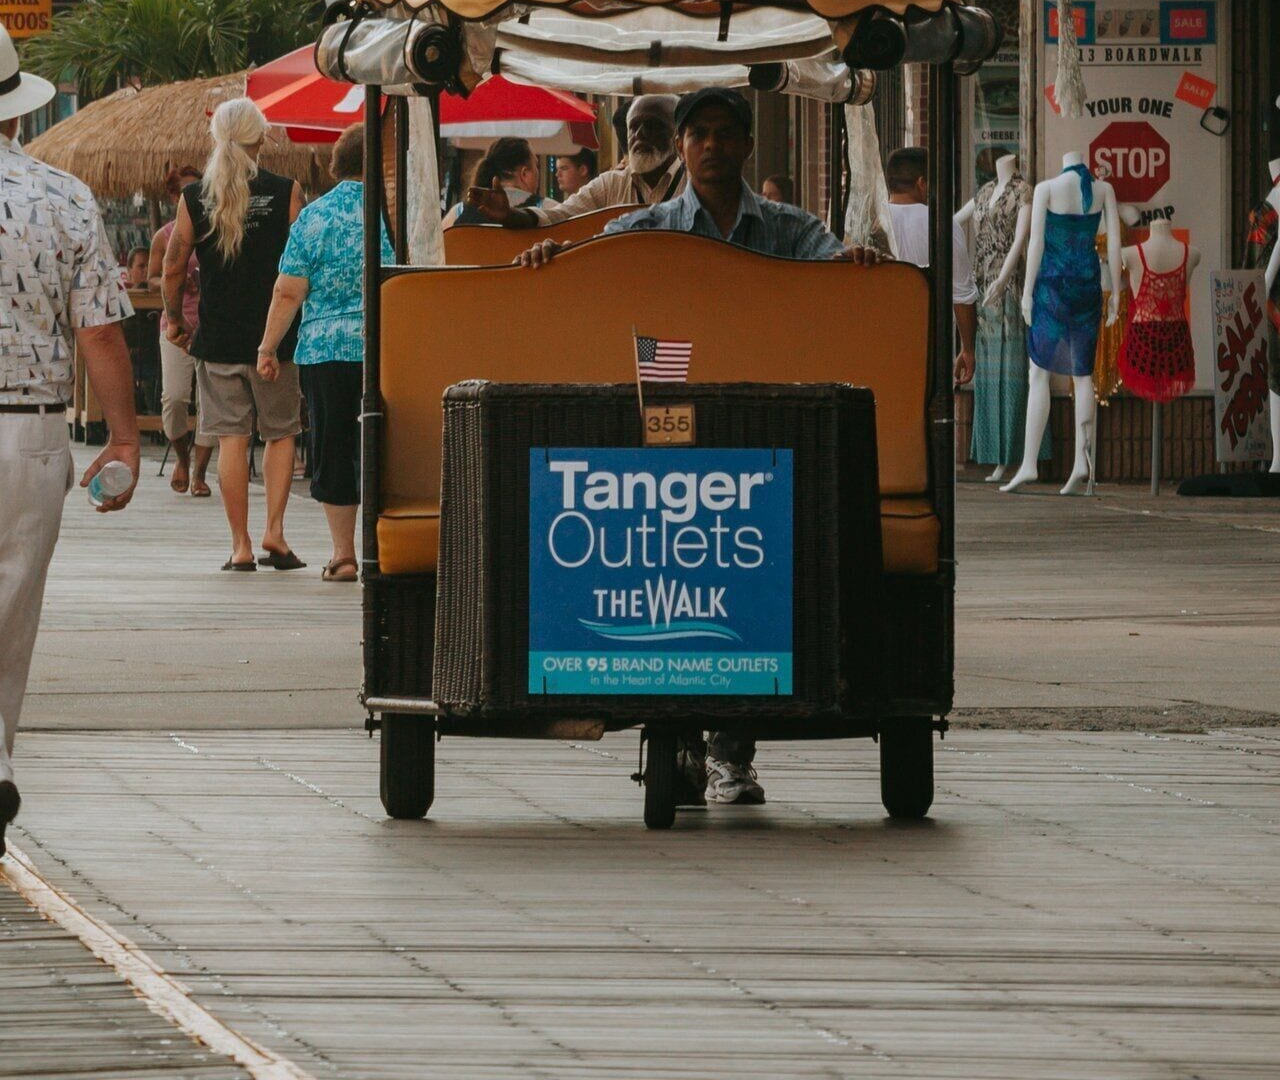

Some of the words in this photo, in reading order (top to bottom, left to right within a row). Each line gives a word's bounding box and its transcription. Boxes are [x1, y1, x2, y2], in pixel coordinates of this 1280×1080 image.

[1174, 17, 1203, 28] SALE
[1105, 47, 1203, 62] BOARDWALK
[1183, 83, 1210, 98] SALE!
[1086, 97, 1132, 118] YOUR
[1139, 97, 1174, 118] ONE
[981, 131, 1014, 141] CHEESE
[1094, 147, 1166, 179] STOP
[1132, 205, 1175, 226] HOP
[1217, 281, 1264, 393] SALE
[647, 416, 690, 433] 355
[549, 461, 765, 523] Tanger
[548, 510, 765, 569] Outlets
[593, 589, 643, 618] THE
[644, 573, 728, 630] WALK
[543, 657, 582, 672] OVER
[586, 657, 609, 671] 95
[613, 657, 663, 672] BRAND
[668, 657, 713, 672] NAME
[717, 657, 779, 672] OUTLETS
[590, 674, 600, 686] in
[603, 674, 619, 685] the
[622, 674, 652, 685] Heart
[654, 674, 666, 686] of
[668, 674, 706, 686] Atlantic
[709, 674, 732, 688] City
